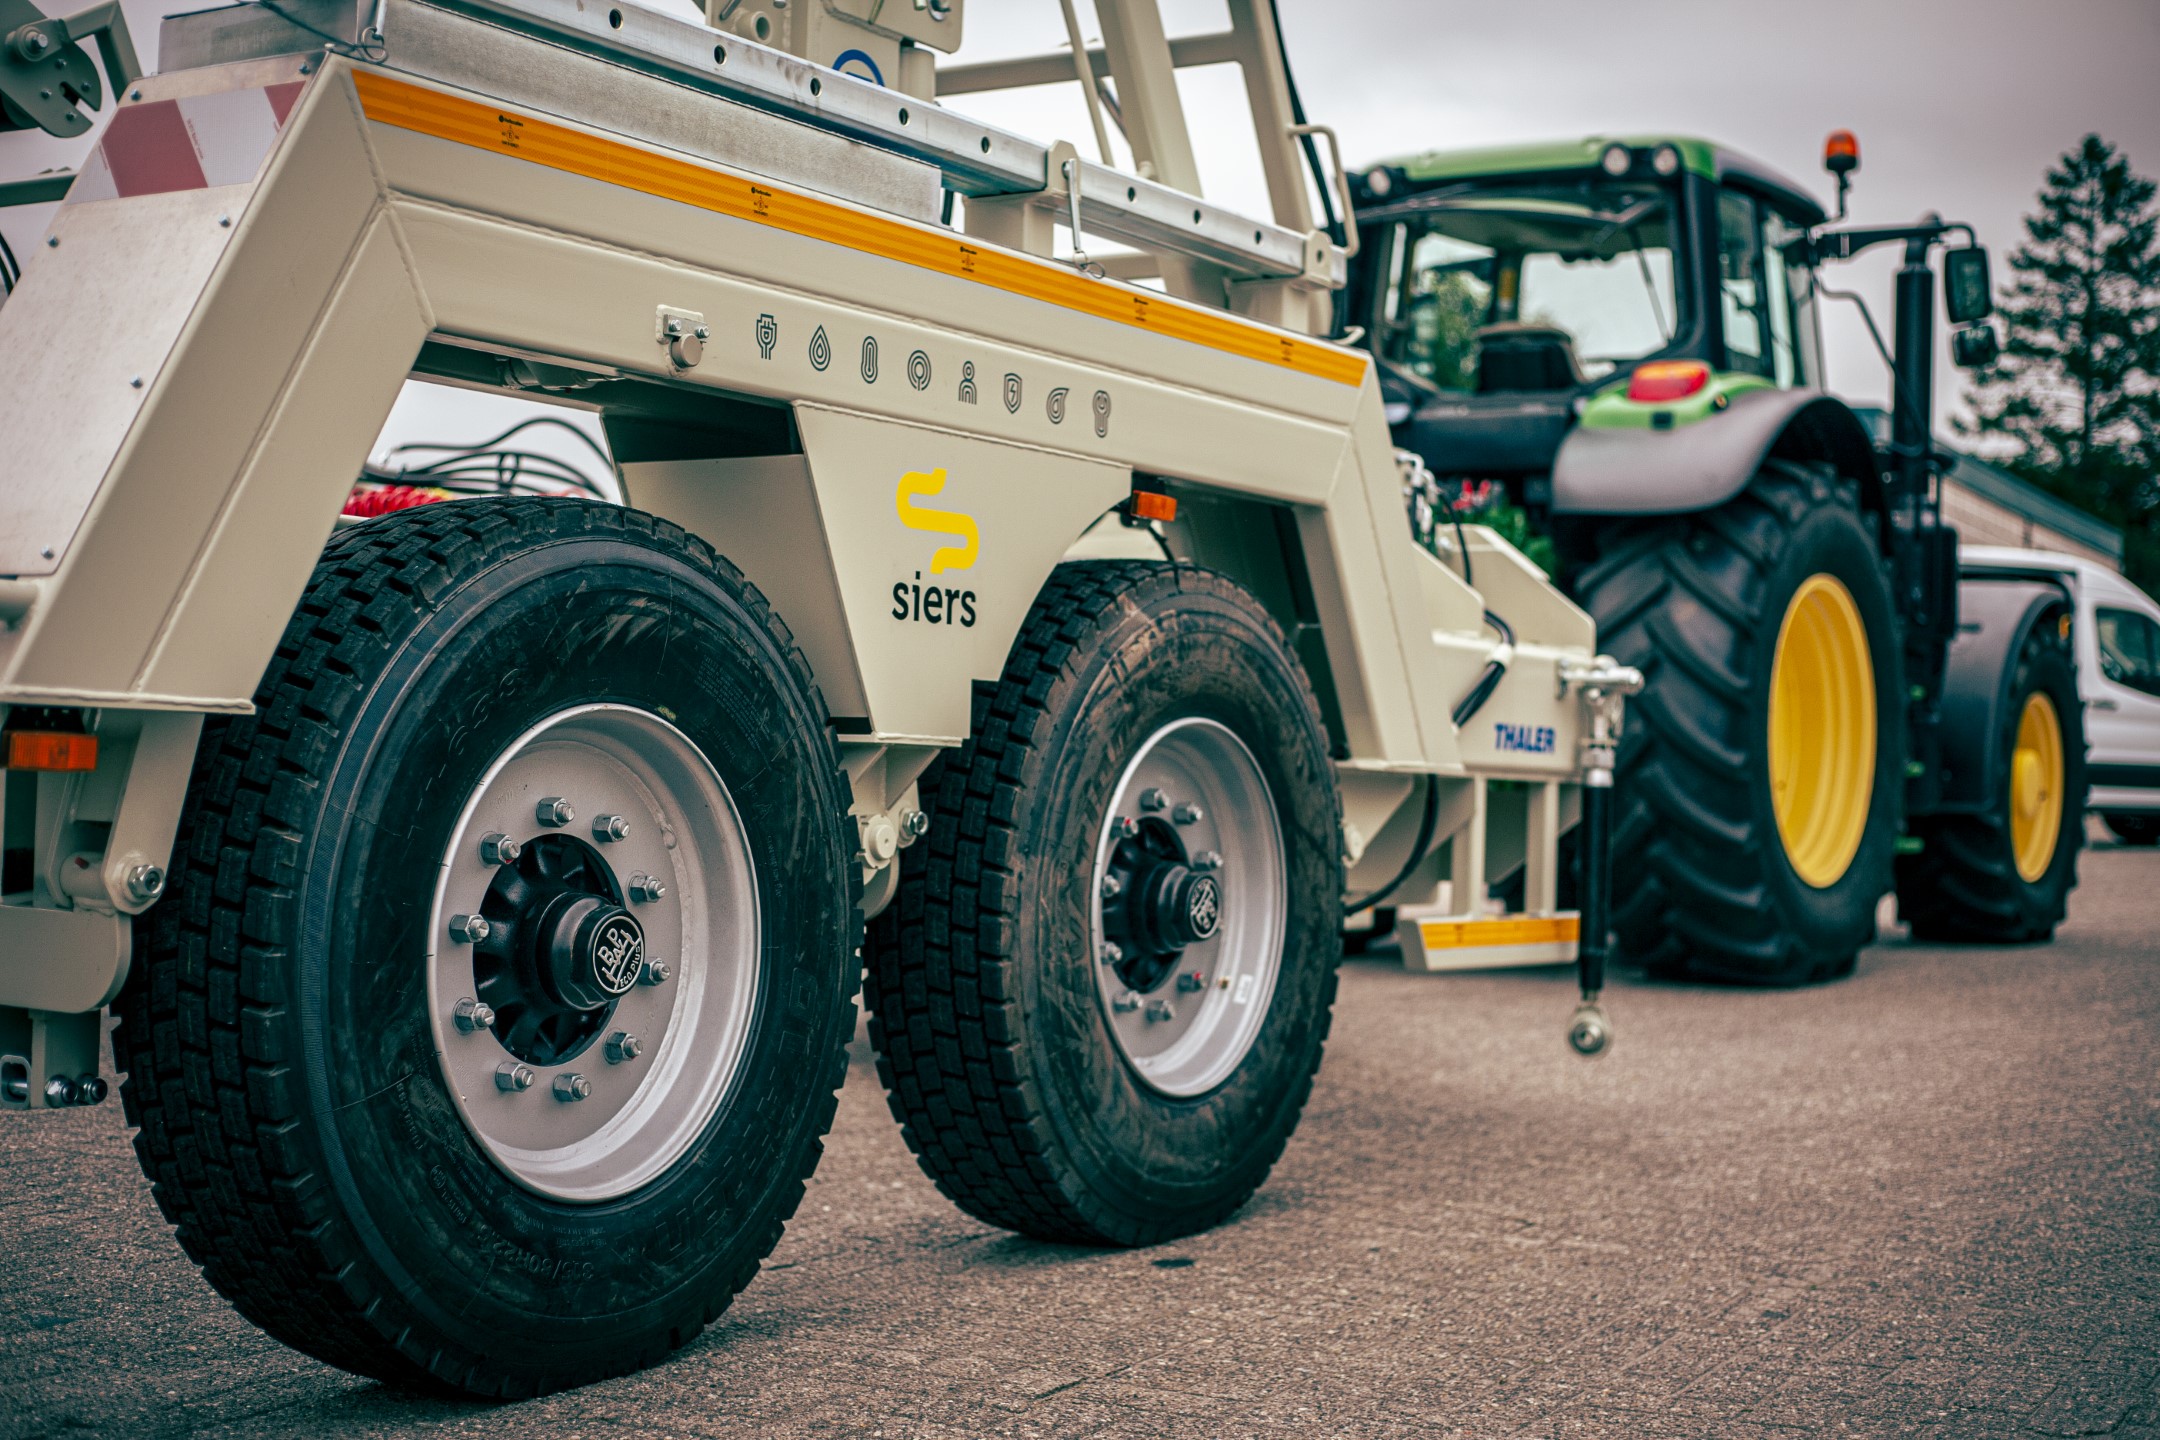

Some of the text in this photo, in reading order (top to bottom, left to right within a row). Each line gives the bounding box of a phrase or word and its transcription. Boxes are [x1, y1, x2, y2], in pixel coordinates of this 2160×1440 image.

[892, 571, 977, 627] siers
[1495, 724, 1556, 753] THALER
[620, 972, 632, 987] ECO
